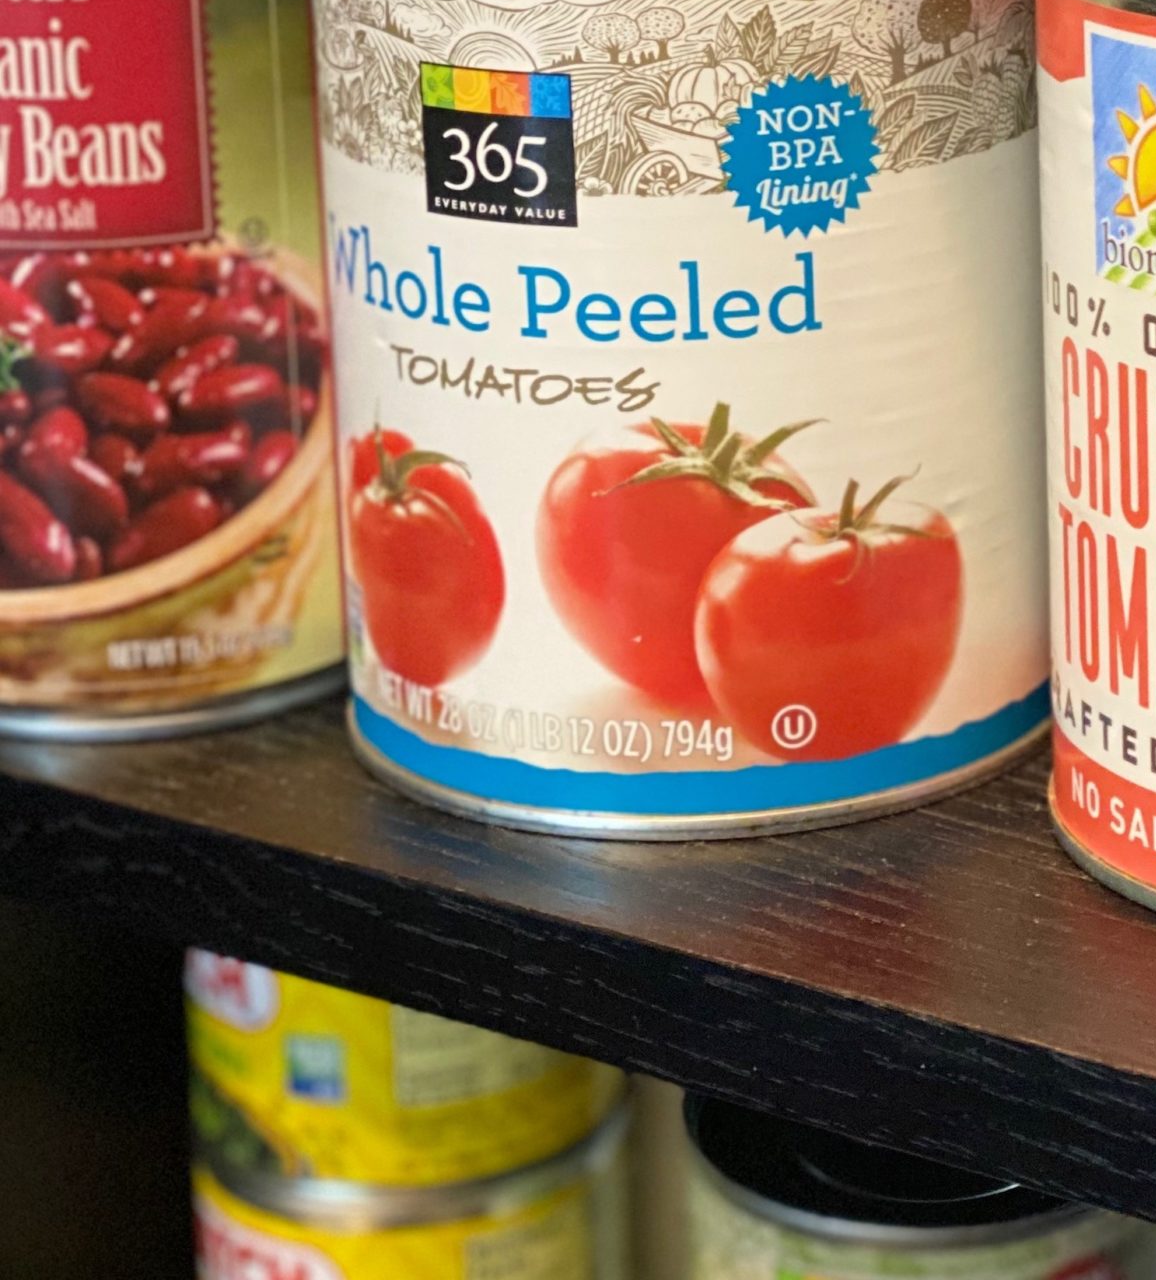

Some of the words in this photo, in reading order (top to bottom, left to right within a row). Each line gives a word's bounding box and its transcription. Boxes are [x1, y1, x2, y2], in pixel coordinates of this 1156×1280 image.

[18, 105, 167, 188] Beans
[756, 102, 856, 136] NON-
[443, 122, 548, 198] 365
[769, 141, 842, 172] BPA
[434, 196, 508, 217] EVERYDAY
[514, 205, 567, 221] VALUE
[330, 210, 490, 333] Whole
[518, 252, 822, 343] Peeled
[391, 344, 662, 414] TOMATOES
[406, 680, 434, 723] WT
[438, 692, 463, 734] 28
[468, 701, 498, 743] OZ
[530, 711, 562, 753] LB
[568, 717, 596, 756] 12
[602, 720, 652, 762] OZ)
[661, 720, 734, 761] 794g
[1071, 766, 1100, 819] NO
